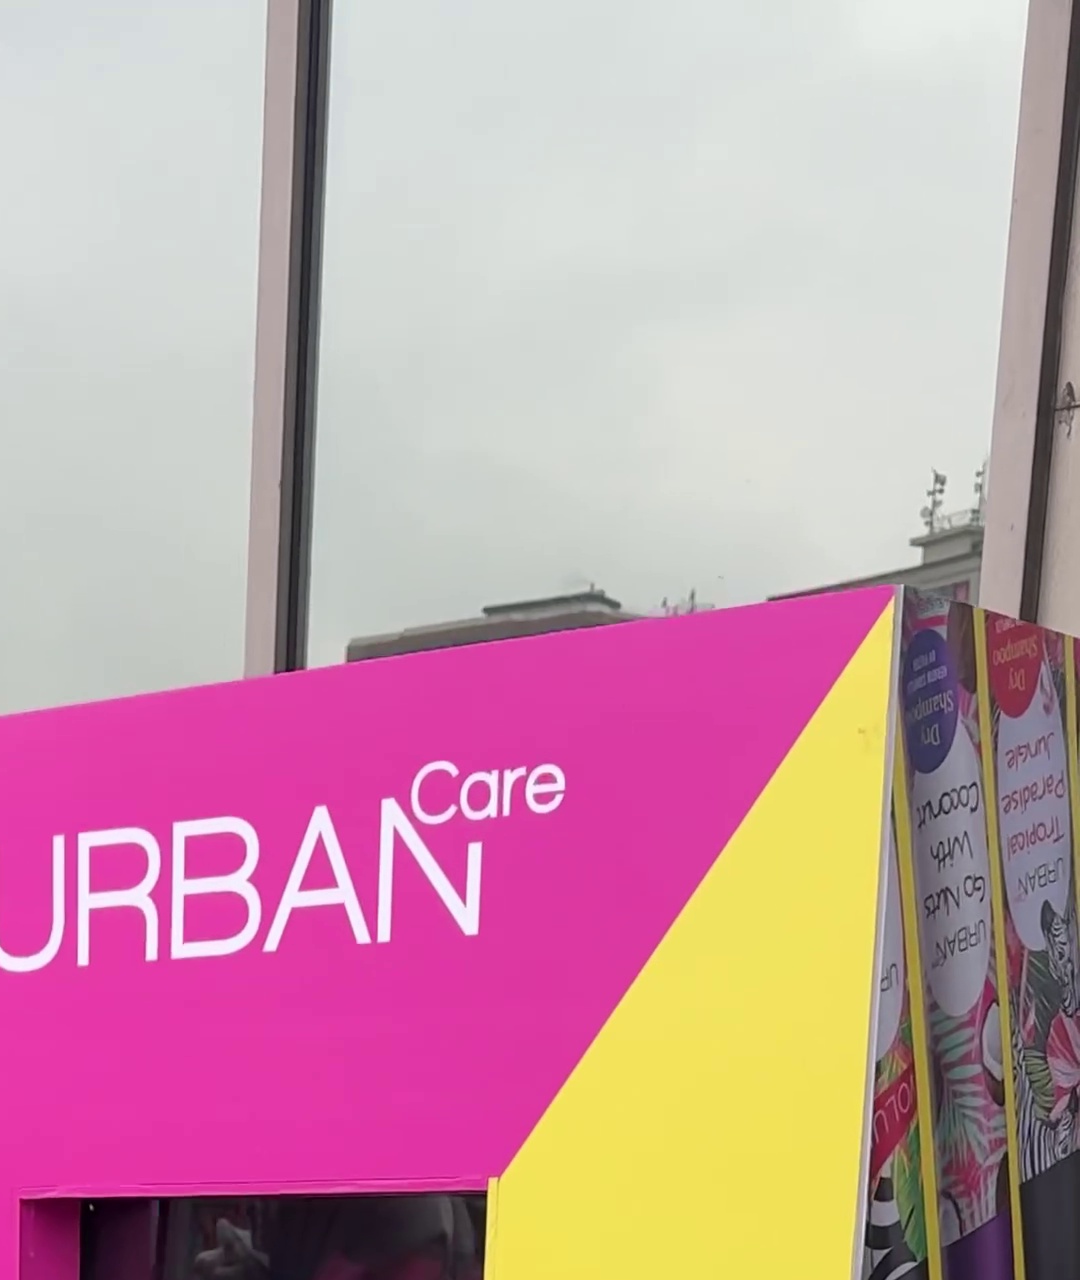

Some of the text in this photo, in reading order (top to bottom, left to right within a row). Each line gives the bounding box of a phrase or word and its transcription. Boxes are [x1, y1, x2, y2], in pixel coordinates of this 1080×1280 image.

[410, 760, 565, 825] Care
[1001, 770, 1065, 815] Paradise
[1007, 816, 1064, 861] Tropical
[1018, 857, 1064, 896] URBAN
